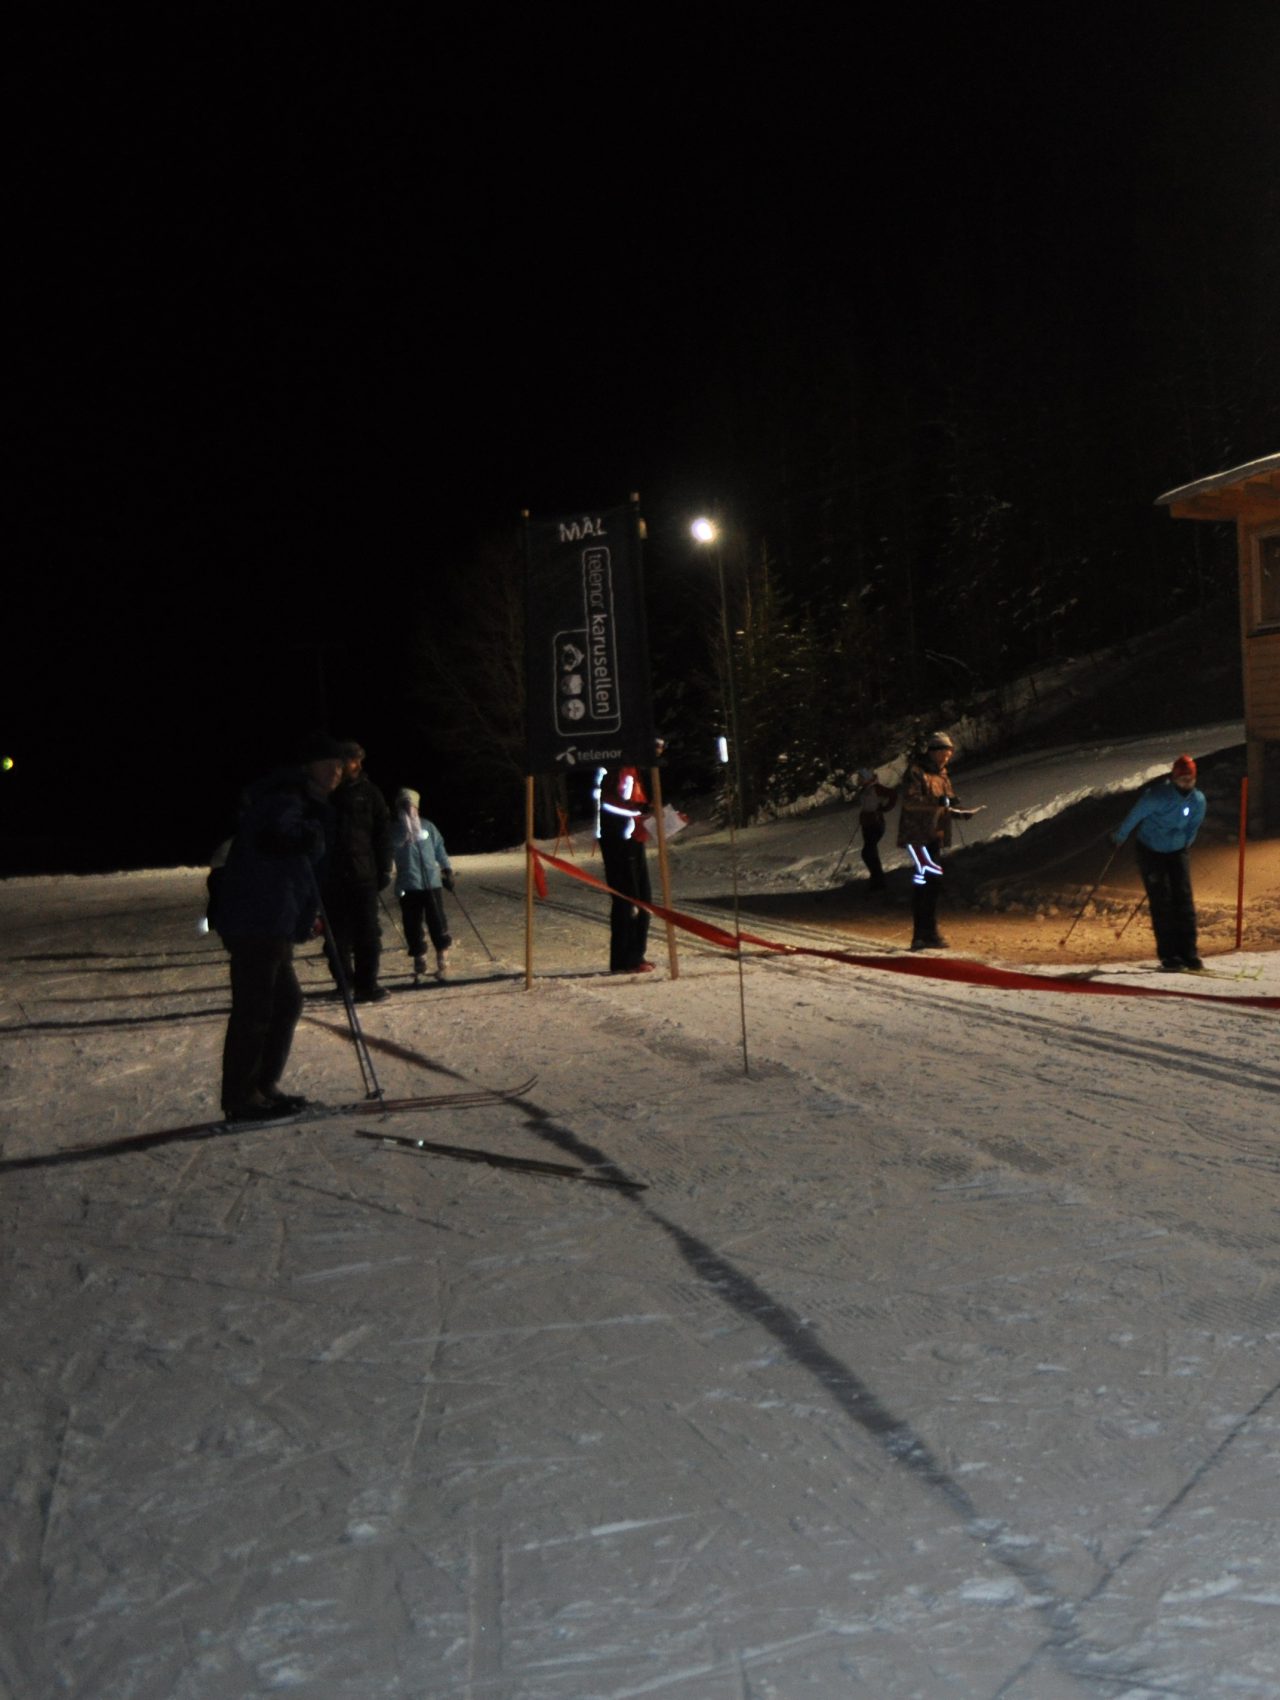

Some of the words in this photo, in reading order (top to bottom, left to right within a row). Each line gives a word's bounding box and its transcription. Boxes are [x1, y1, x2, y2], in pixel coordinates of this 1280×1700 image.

[559, 516, 608, 543] MÅL
[588, 554, 604, 609] telenor
[591, 613, 613, 714] karusellen
[577, 748, 623, 762] telenor
